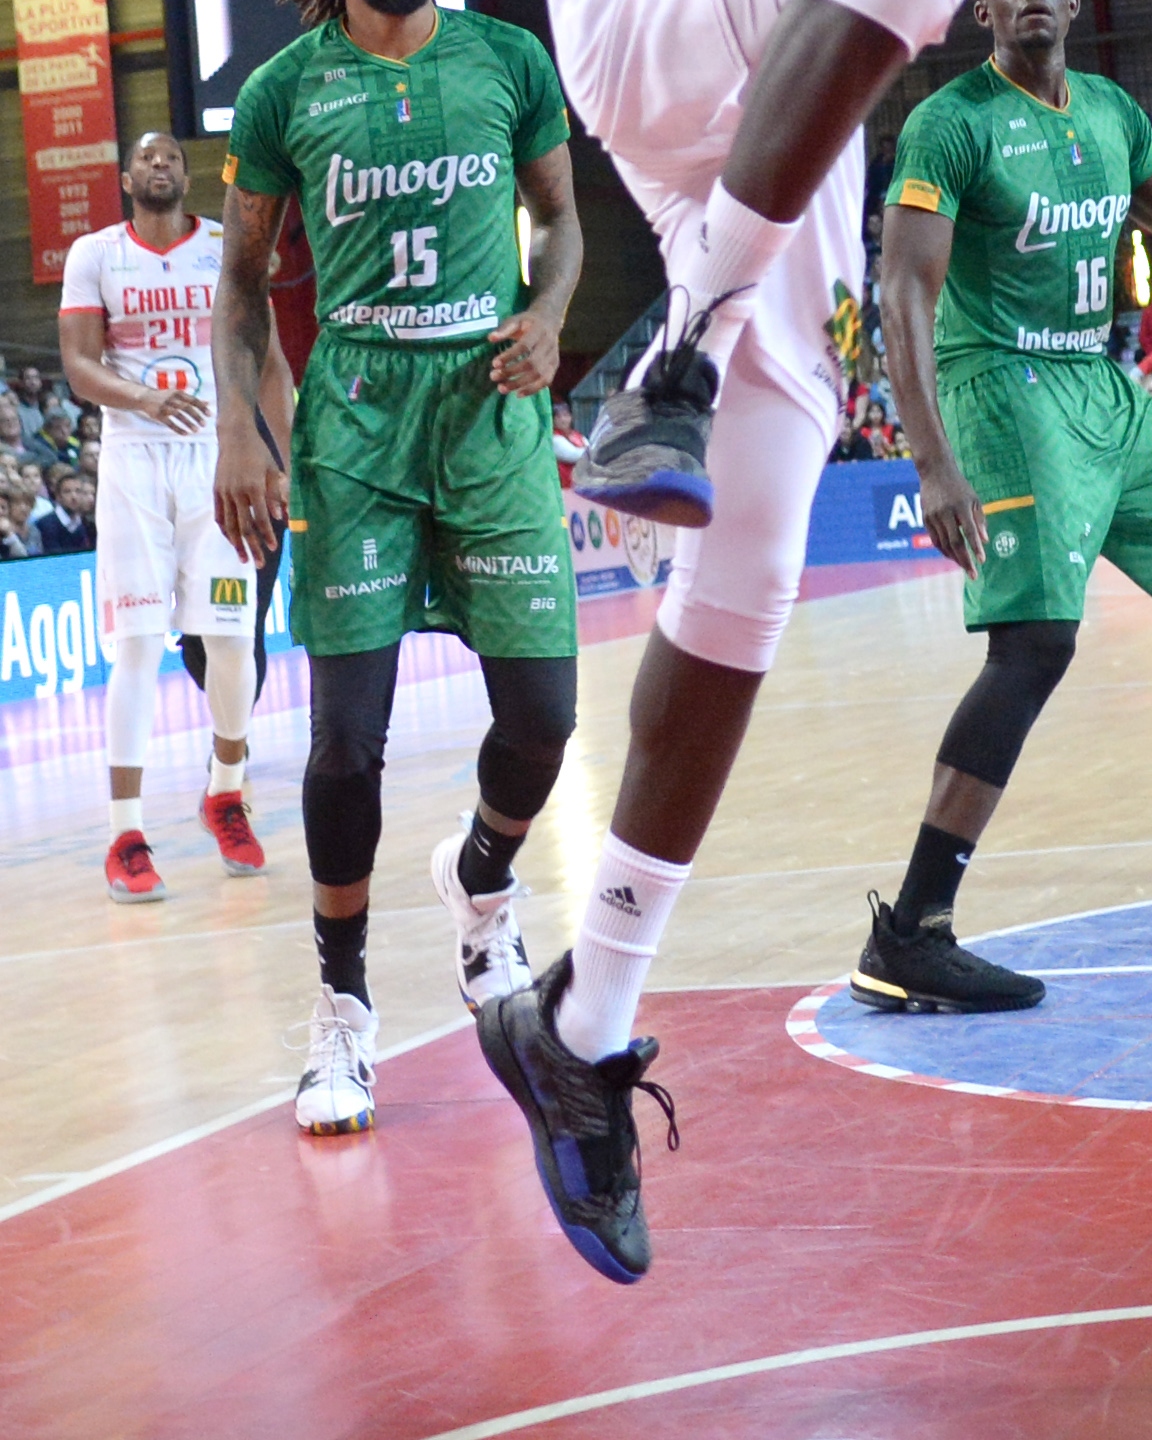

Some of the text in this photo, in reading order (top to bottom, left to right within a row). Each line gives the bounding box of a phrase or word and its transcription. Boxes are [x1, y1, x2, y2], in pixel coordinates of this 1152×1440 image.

[323, 92, 369, 113] EIFFAGE
[325, 152, 499, 228] Limoges
[386, 225, 439, 288] 15
[122, 284, 214, 316] CHOLET
[1074, 256, 1107, 315] 16
[148, 316, 192, 350] 24
[324, 572, 408, 600] EMAKINA
[599, 892, 642, 917] adidas
